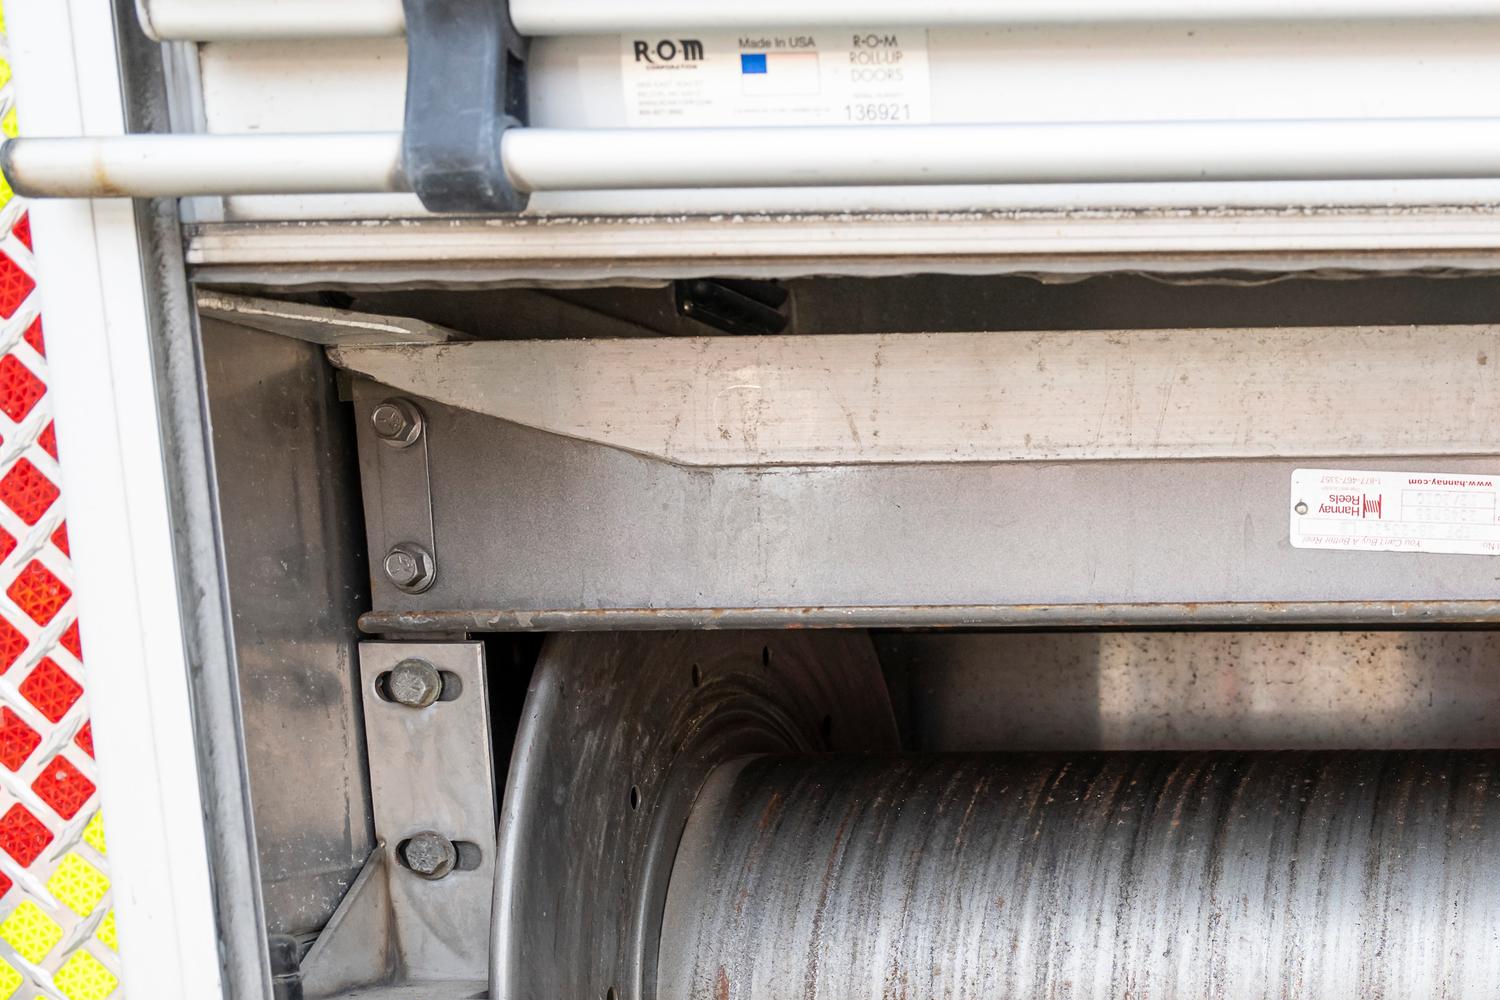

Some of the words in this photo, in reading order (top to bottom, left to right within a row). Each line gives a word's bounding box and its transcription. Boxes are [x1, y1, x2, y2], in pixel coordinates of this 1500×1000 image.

[738, 35, 771, 49] Made
[775, 36, 786, 48] In
[789, 35, 816, 48] USA
[850, 50, 902, 65] ROLL-UP
[851, 67, 904, 82] DOORS
[846, 103, 910, 121] 136921
[1408, 478, 1493, 488] www.hannay.com
[1329, 494, 1360, 505] Reels
[1318, 503, 1360, 517] Hannay
[1362, 536, 1378, 547] Buy
[1404, 539, 1421, 547] You
